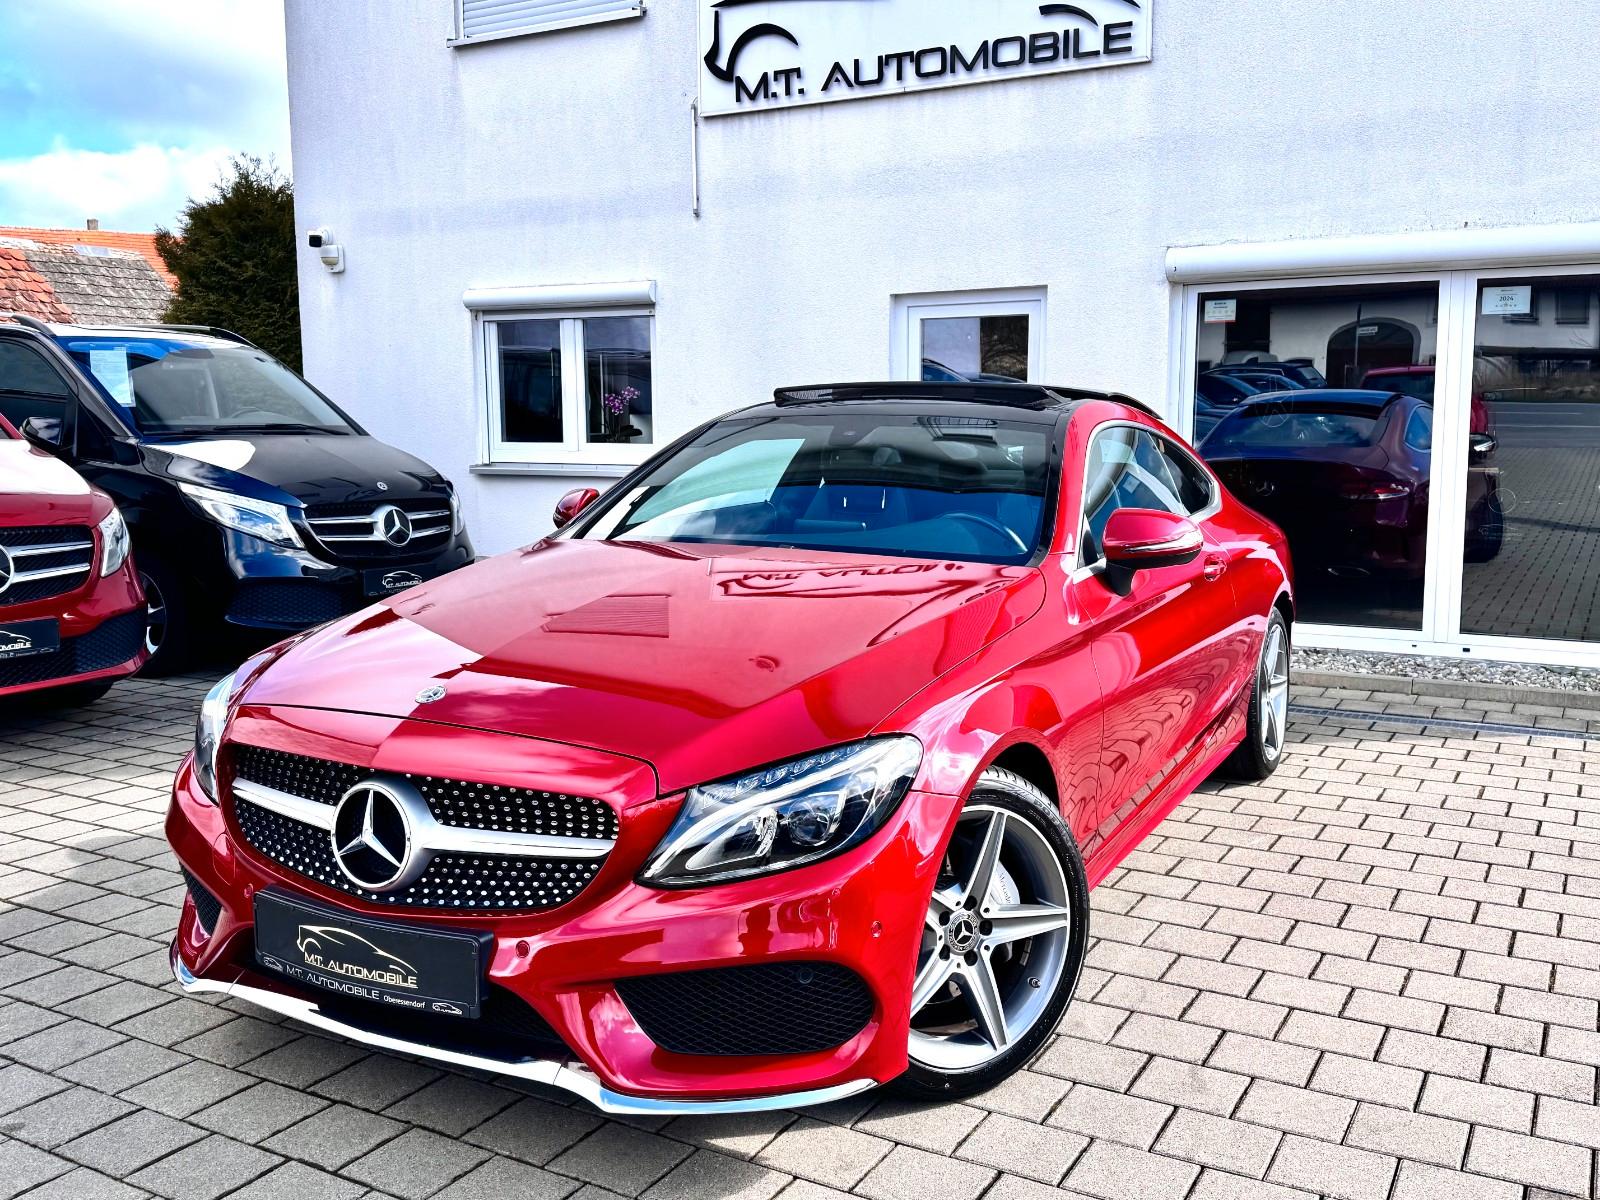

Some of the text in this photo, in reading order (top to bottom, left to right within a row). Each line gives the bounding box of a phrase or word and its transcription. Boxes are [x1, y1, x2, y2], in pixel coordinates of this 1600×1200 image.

[735, 21, 1134, 103] M.T. AUTOMOBILE
[304, 951, 324, 967] M.T.
[327, 960, 417, 987] AUTOMOBILE
[307, 973, 380, 1000] AUTOMOBILE
[384, 994, 426, 1009] Oberessendorf
